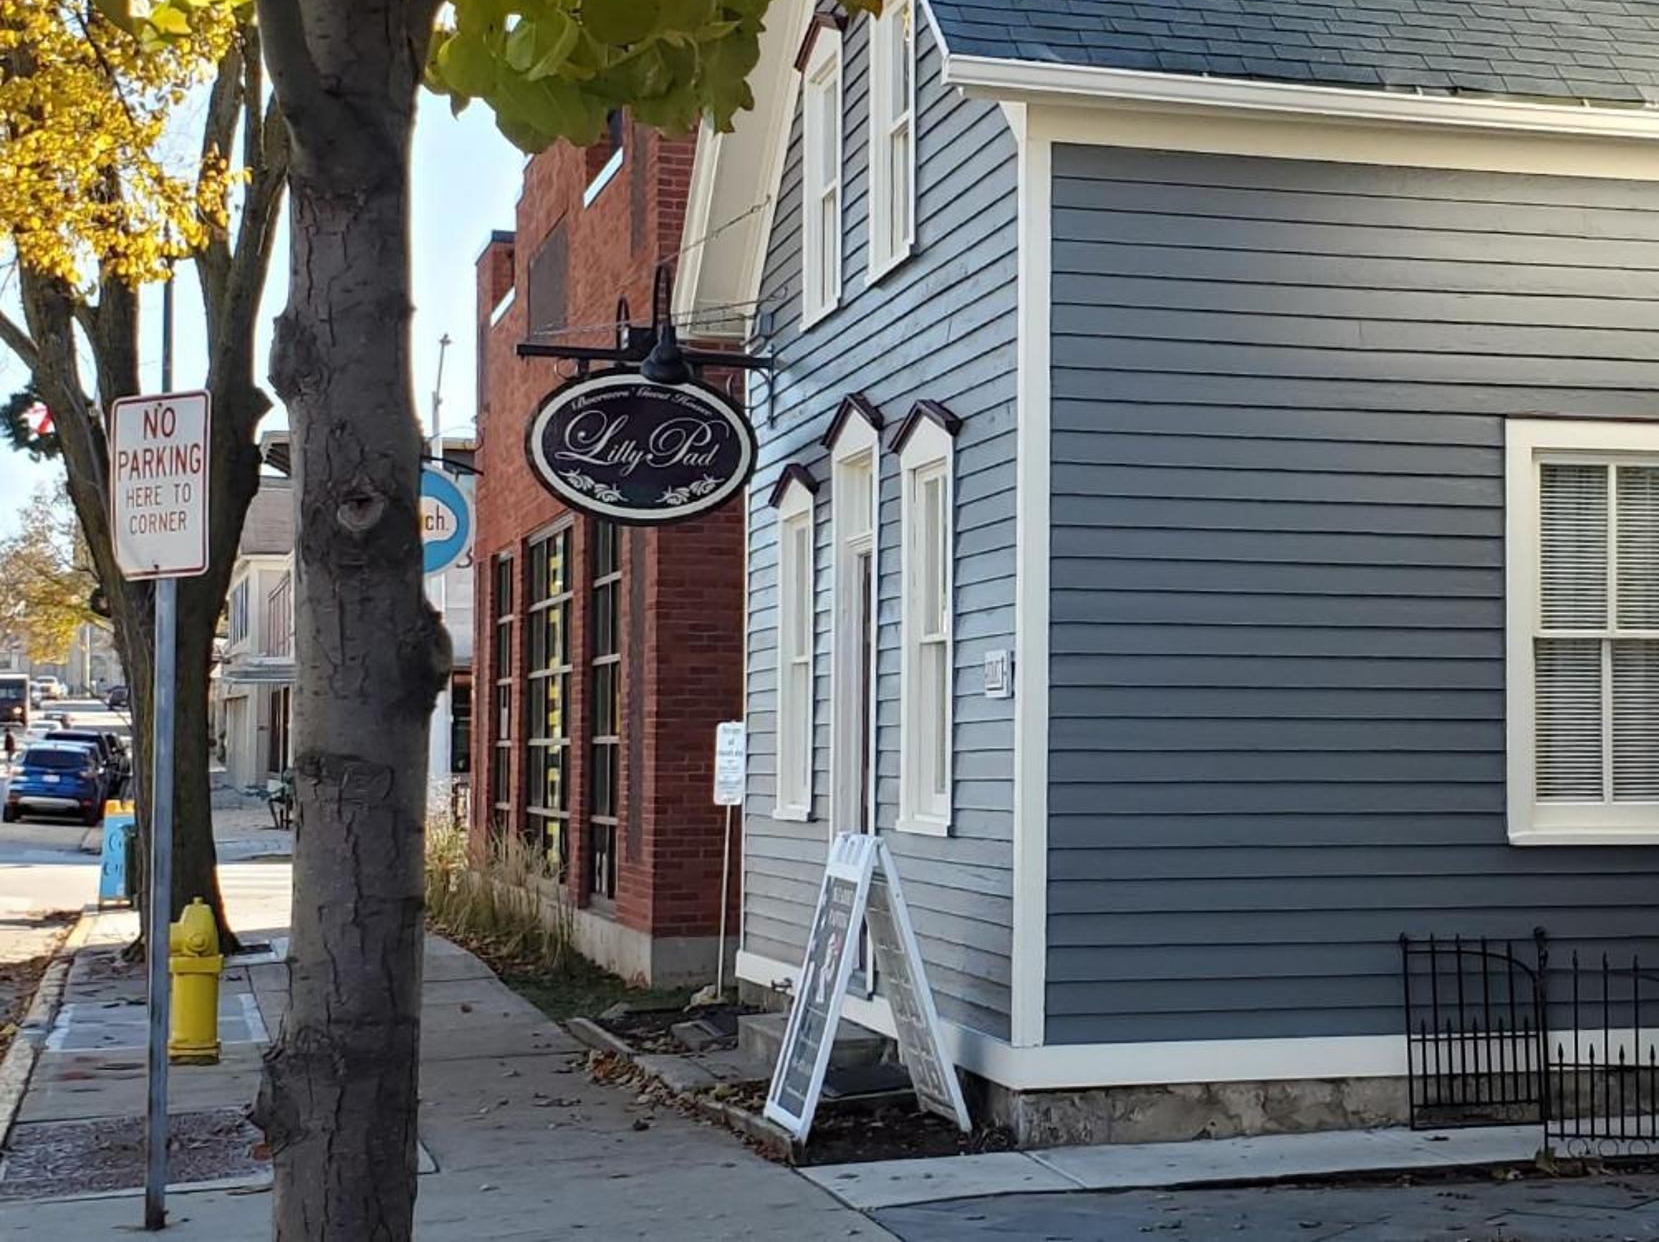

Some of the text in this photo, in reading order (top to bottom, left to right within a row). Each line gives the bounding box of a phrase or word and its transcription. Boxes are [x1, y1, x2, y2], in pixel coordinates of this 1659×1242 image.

[143, 407, 176, 440] NO
[554, 410, 729, 476] Lilly Pad
[118, 443, 202, 481] PARKING
[126, 482, 191, 508] HERE TO
[129, 511, 188, 535] CORNER
